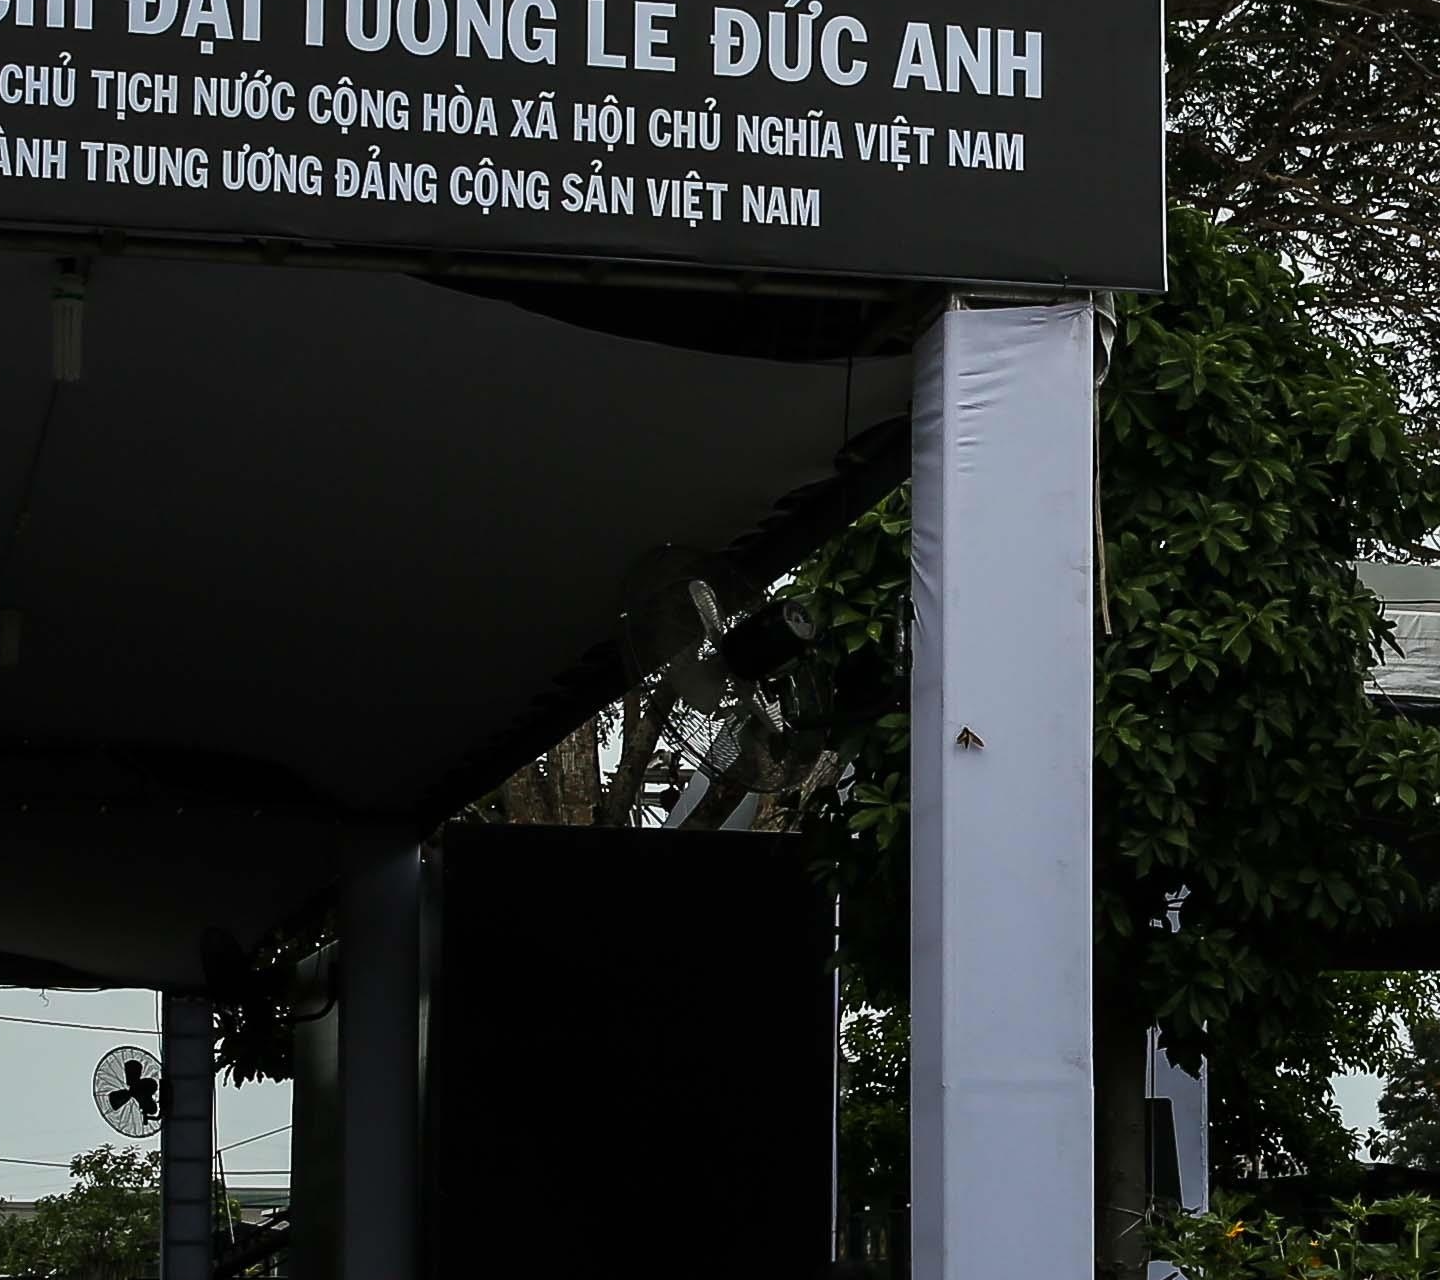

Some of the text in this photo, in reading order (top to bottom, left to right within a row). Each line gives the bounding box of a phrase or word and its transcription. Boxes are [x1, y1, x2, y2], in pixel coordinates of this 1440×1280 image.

[892, 21, 1043, 99] ANH
[90, 69, 178, 121] TỊCH
[193, 69, 296, 122] NƯỚC
[308, 76, 410, 135] CỘNG
[422, 83, 499, 137] HÒA
[509, 90, 559, 141] XÃ
[573, 94, 636, 152] HỘI
[648, 96, 721, 151] CHỦ
[736, 109, 844, 160] NGHĨA
[854, 115, 935, 172] VIỆT
[948, 128, 1025, 172] NAM
[80, 141, 209, 189] TRUNG
[222, 143, 323, 197] ƯƠNG
[334, 144, 438, 205] ĐẢNG
[449, 157, 550, 215] CỘNG
[560, 159, 634, 216] SẢN
[646, 170, 729, 228] VIỆT
[742, 184, 820, 227] NAM
